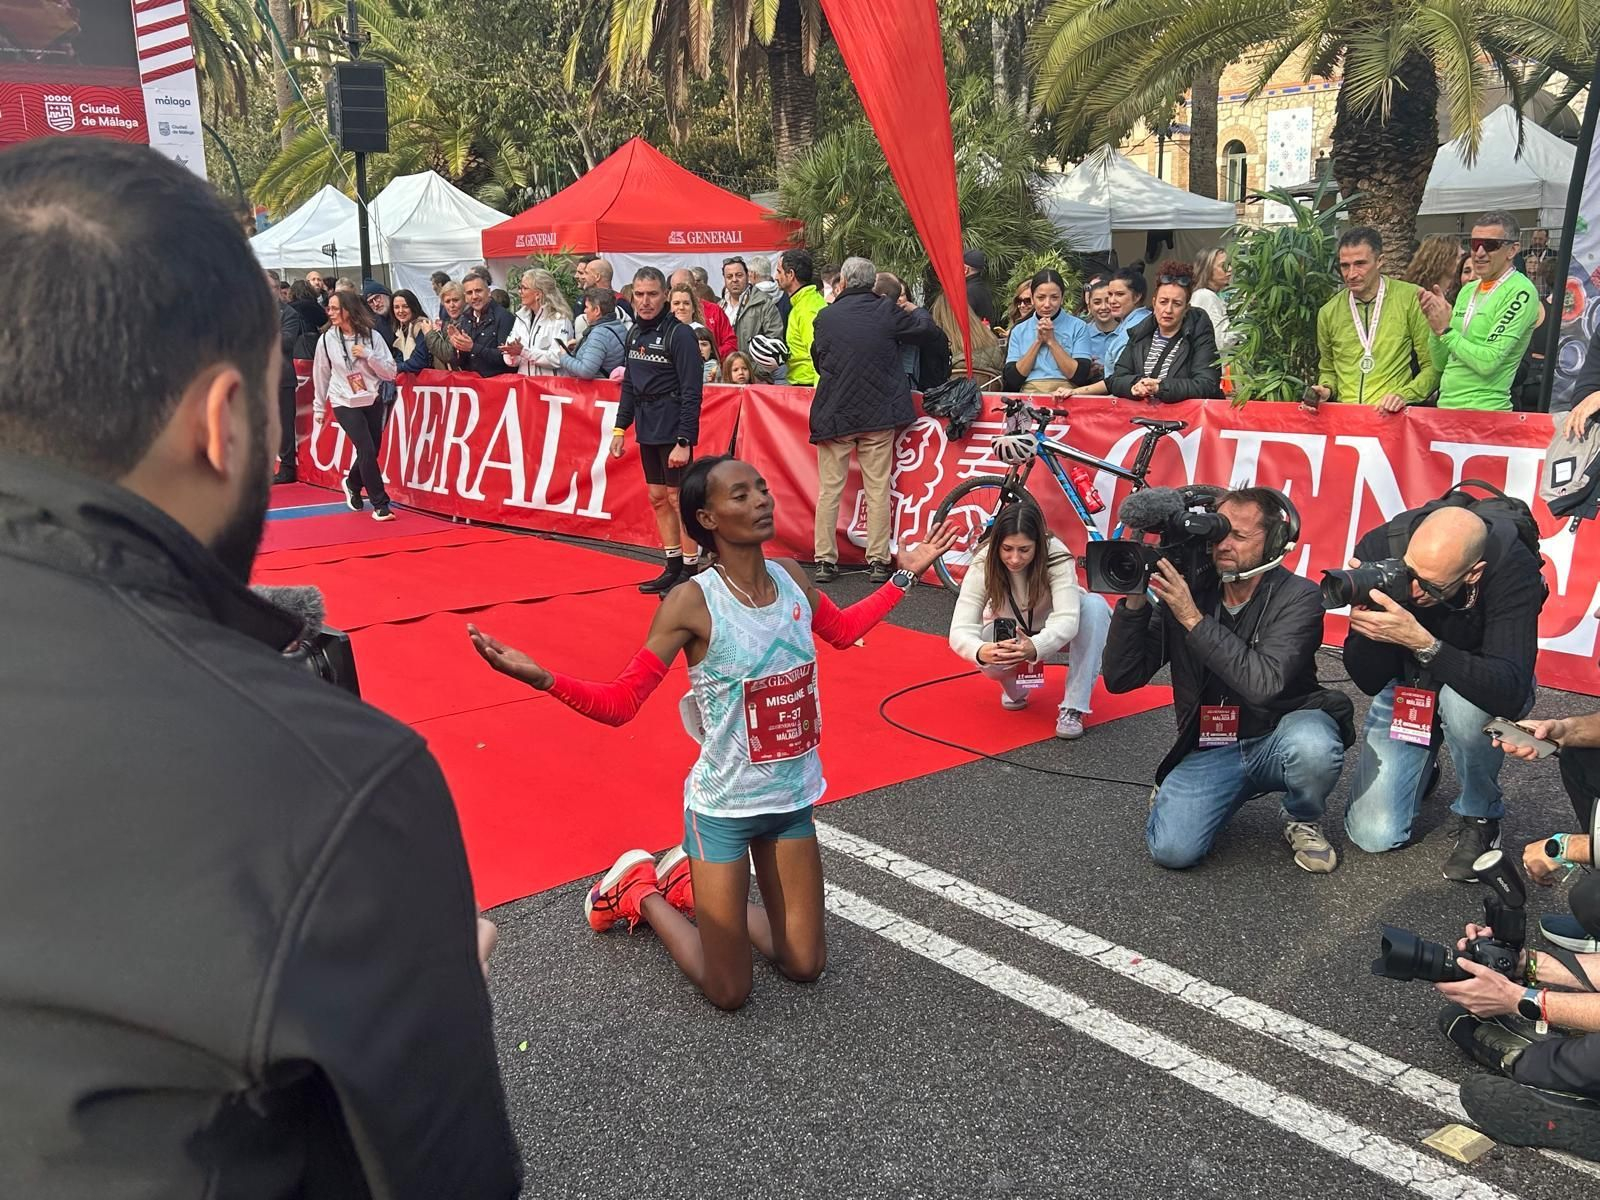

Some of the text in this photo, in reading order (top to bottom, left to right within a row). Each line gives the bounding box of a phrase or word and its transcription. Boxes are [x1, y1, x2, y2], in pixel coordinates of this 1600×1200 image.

[79, 103, 120, 114] Ciudad
[155, 96, 191, 107] málaga
[82, 117, 139, 128] de Málaga
[525, 232, 557, 247] GENERALI
[687, 231, 742, 244] GENERALI
[310, 386, 620, 519] GNERALI
[769, 665, 810, 687] GENERALI
[779, 707, 801, 722] F-37
